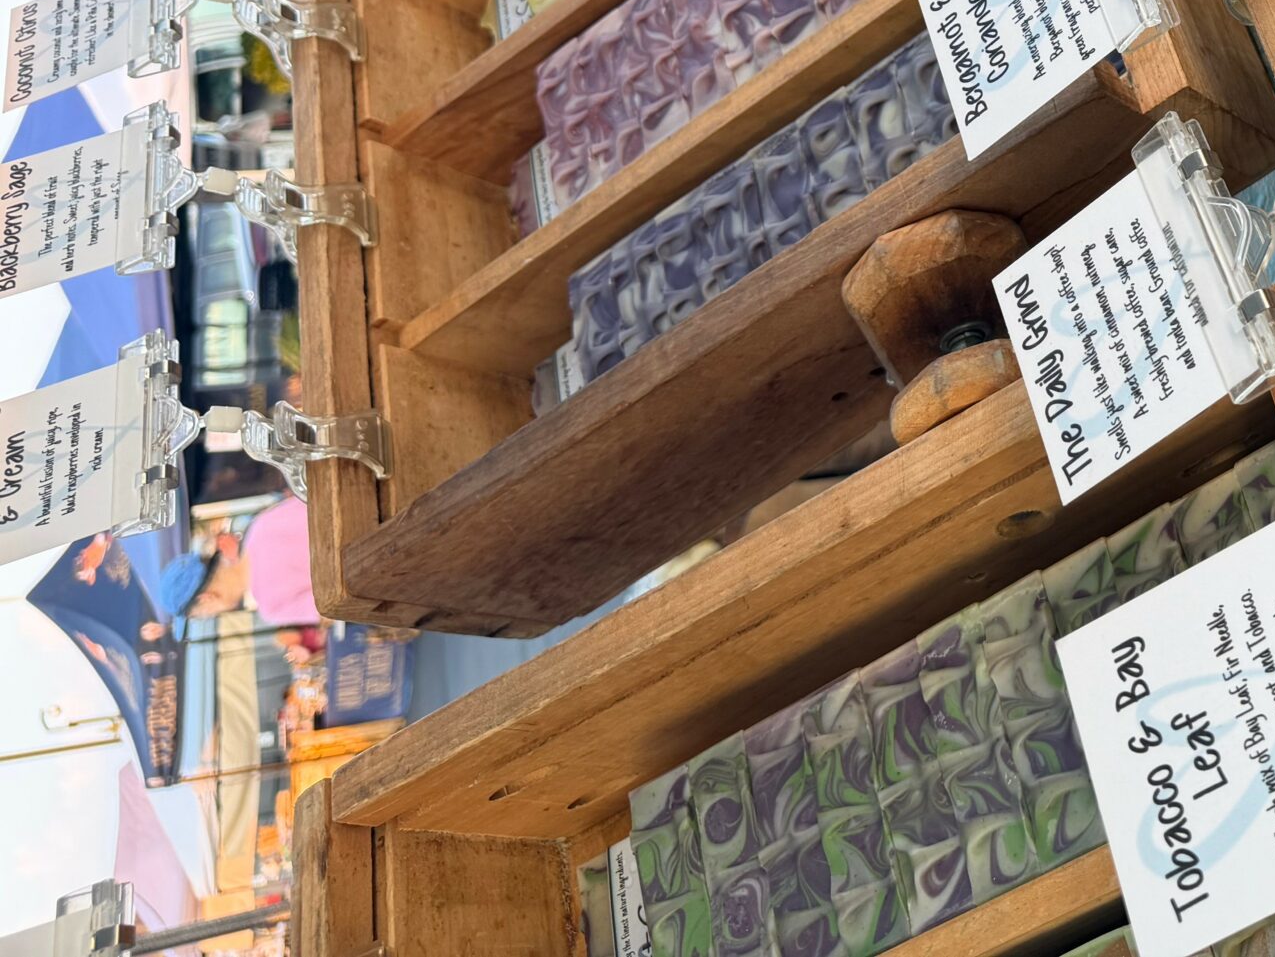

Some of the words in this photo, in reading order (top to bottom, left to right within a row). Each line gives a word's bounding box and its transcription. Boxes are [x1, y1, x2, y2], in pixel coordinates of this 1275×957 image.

[14, 3, 38, 43] Citrus
[1021, 15, 1041, 63] energizing
[1040, 13, 1064, 62] Bergamot
[1075, 34, 1096, 61] green
[10, 44, 35, 102] Coconut
[937, 12, 988, 126] Bergamot
[1, 162, 33, 200] Sage
[0, 202, 29, 292] Blackberry
[1105, 227, 1119, 254] cane,
[1129, 218, 1148, 249] coffee
[1043, 244, 1066, 274] shop!
[1081, 243, 1101, 287] nutmeg,
[1113, 256, 1133, 285] sugar
[1137, 248, 1164, 293] Ground
[1058, 272, 1076, 304] coffee
[1124, 283, 1144, 318] coffee,
[1159, 289, 1175, 322] bean.
[1005, 273, 1048, 351] Grind
[1073, 312, 1088, 336] into
[1096, 286, 1120, 338] cinnamon,
[1082, 329, 1102, 374] walking
[1167, 317, 1187, 351] tonka
[1117, 351, 1133, 374] mix
[1133, 318, 1174, 401] freshly-brewed
[1176, 348, 1196, 369] and
[1035, 349, 1073, 423] Daily
[1093, 373, 1109, 398] like
[1125, 374, 1144, 404] sweet
[47, 407, 63, 425] ripe,
[1100, 394, 1125, 419] just
[45, 425, 62, 448] juicy,
[65, 412, 86, 447] enveloped
[94, 428, 104, 454] cream.
[1107, 416, 1131, 460] Smells
[0, 431, 25, 498] Cream
[39, 457, 55, 483] fusion
[64, 448, 83, 492] raspberries
[89, 454, 102, 471] rich
[1061, 423, 1092, 486] The
[36, 482, 53, 519] beautiful
[61, 492, 76, 516] black
[1207, 605, 1234, 657] Needle,
[1241, 588, 1266, 652] Tobacco.
[1111, 636, 1150, 712] Bay
[1222, 657, 1242, 681] Fir
[1253, 648, 1275, 673] and
[1229, 678, 1254, 719] Leaf,
[1128, 720, 1163, 754] &
[1244, 714, 1267, 750] Bay
[1170, 711, 1228, 800] Leaf
[1147, 764, 1209, 923] Tobacco
[615, 851, 629, 891] ingredients.
[617, 890, 629, 915] natural
[620, 917, 631, 939] finest
